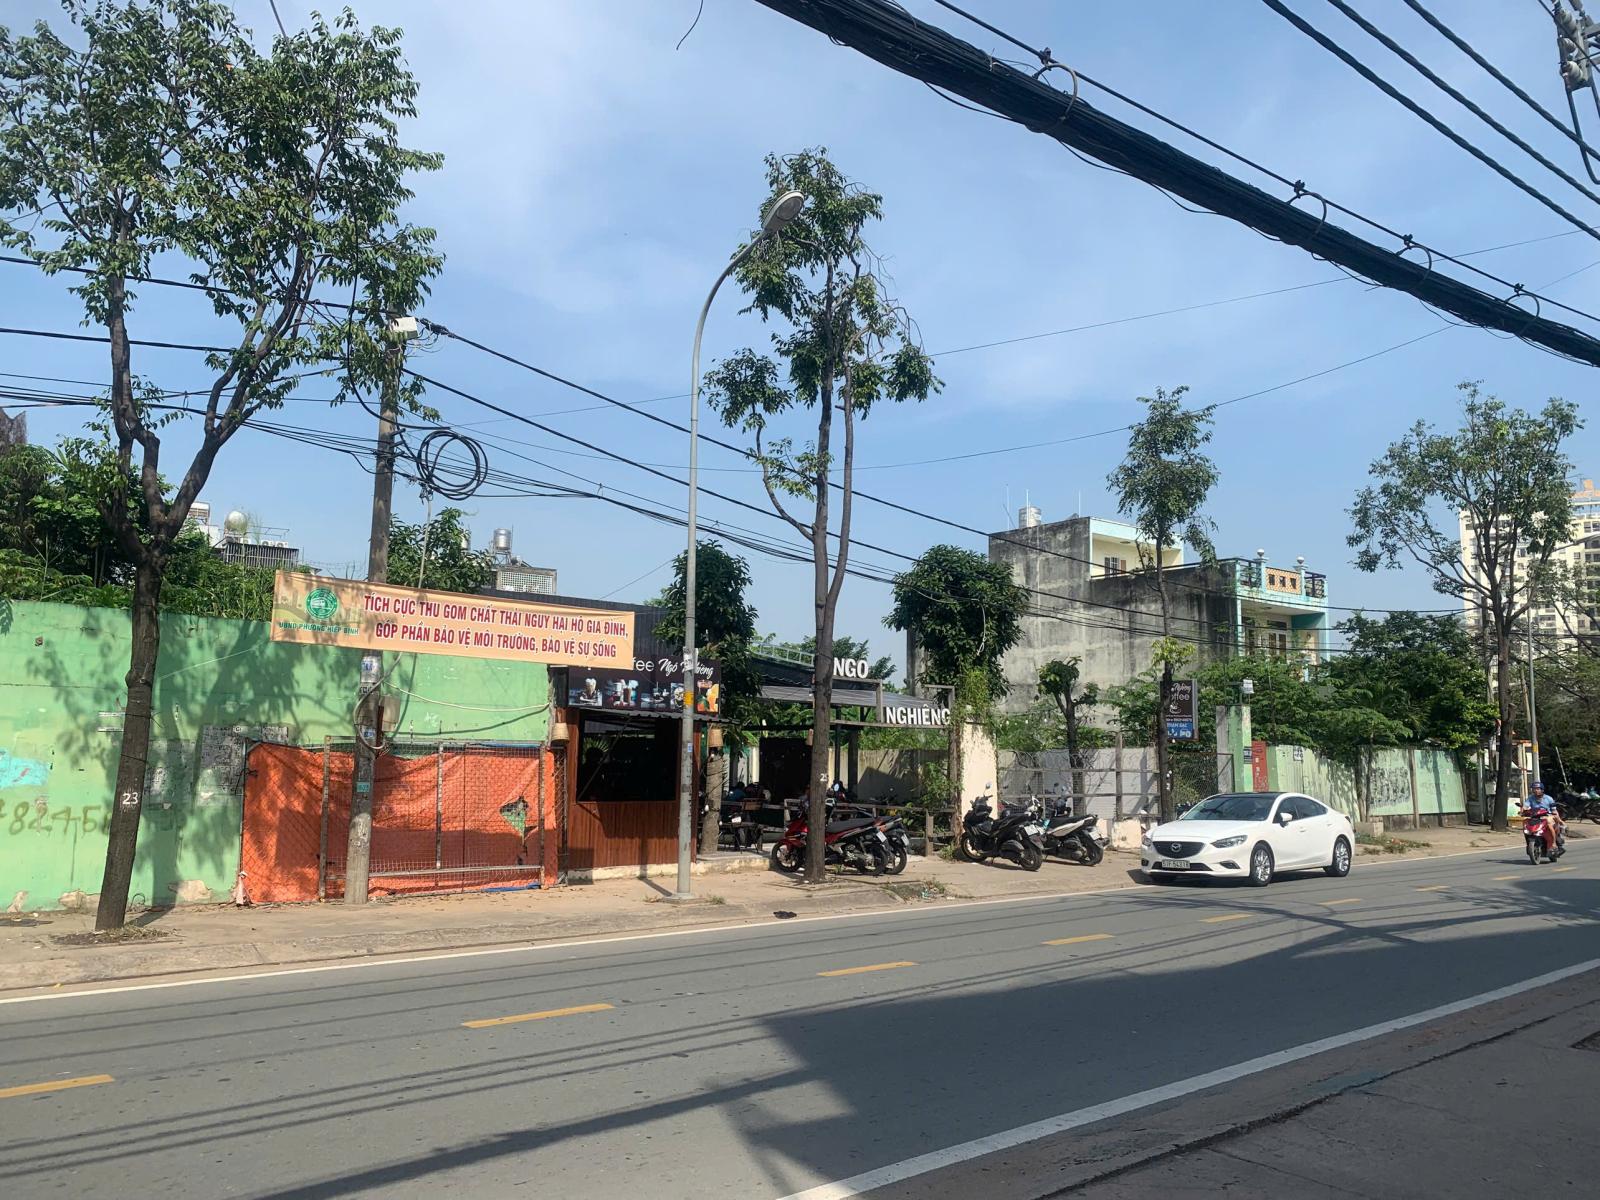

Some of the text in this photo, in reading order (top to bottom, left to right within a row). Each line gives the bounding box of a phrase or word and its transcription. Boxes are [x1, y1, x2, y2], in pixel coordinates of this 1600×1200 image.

[364, 592, 390, 613] TÍCH
[393, 598, 416, 618] CỰC
[420, 601, 440, 618] THU
[443, 604, 467, 620] GOM
[470, 604, 497, 624] CHẤT
[499, 608, 522, 627] THẢI
[524, 612, 551, 629] NGUY
[552, 616, 568, 633] HẠI
[571, 616, 584, 635] HỘ
[586, 619, 601, 634] GIA
[375, 620, 398, 639] GÓP
[401, 621, 431, 642] PHẦN
[433, 625, 454, 644] BẢO
[458, 627, 471, 648] VỆ
[474, 630, 493, 648] MÔI
[563, 638, 576, 657] VỆ
[577, 641, 590, 658] SỰ
[592, 639, 617, 658] SỐNG
[886, 703, 951, 726] NGHIÊNG
[122, 791, 139, 805] 23
